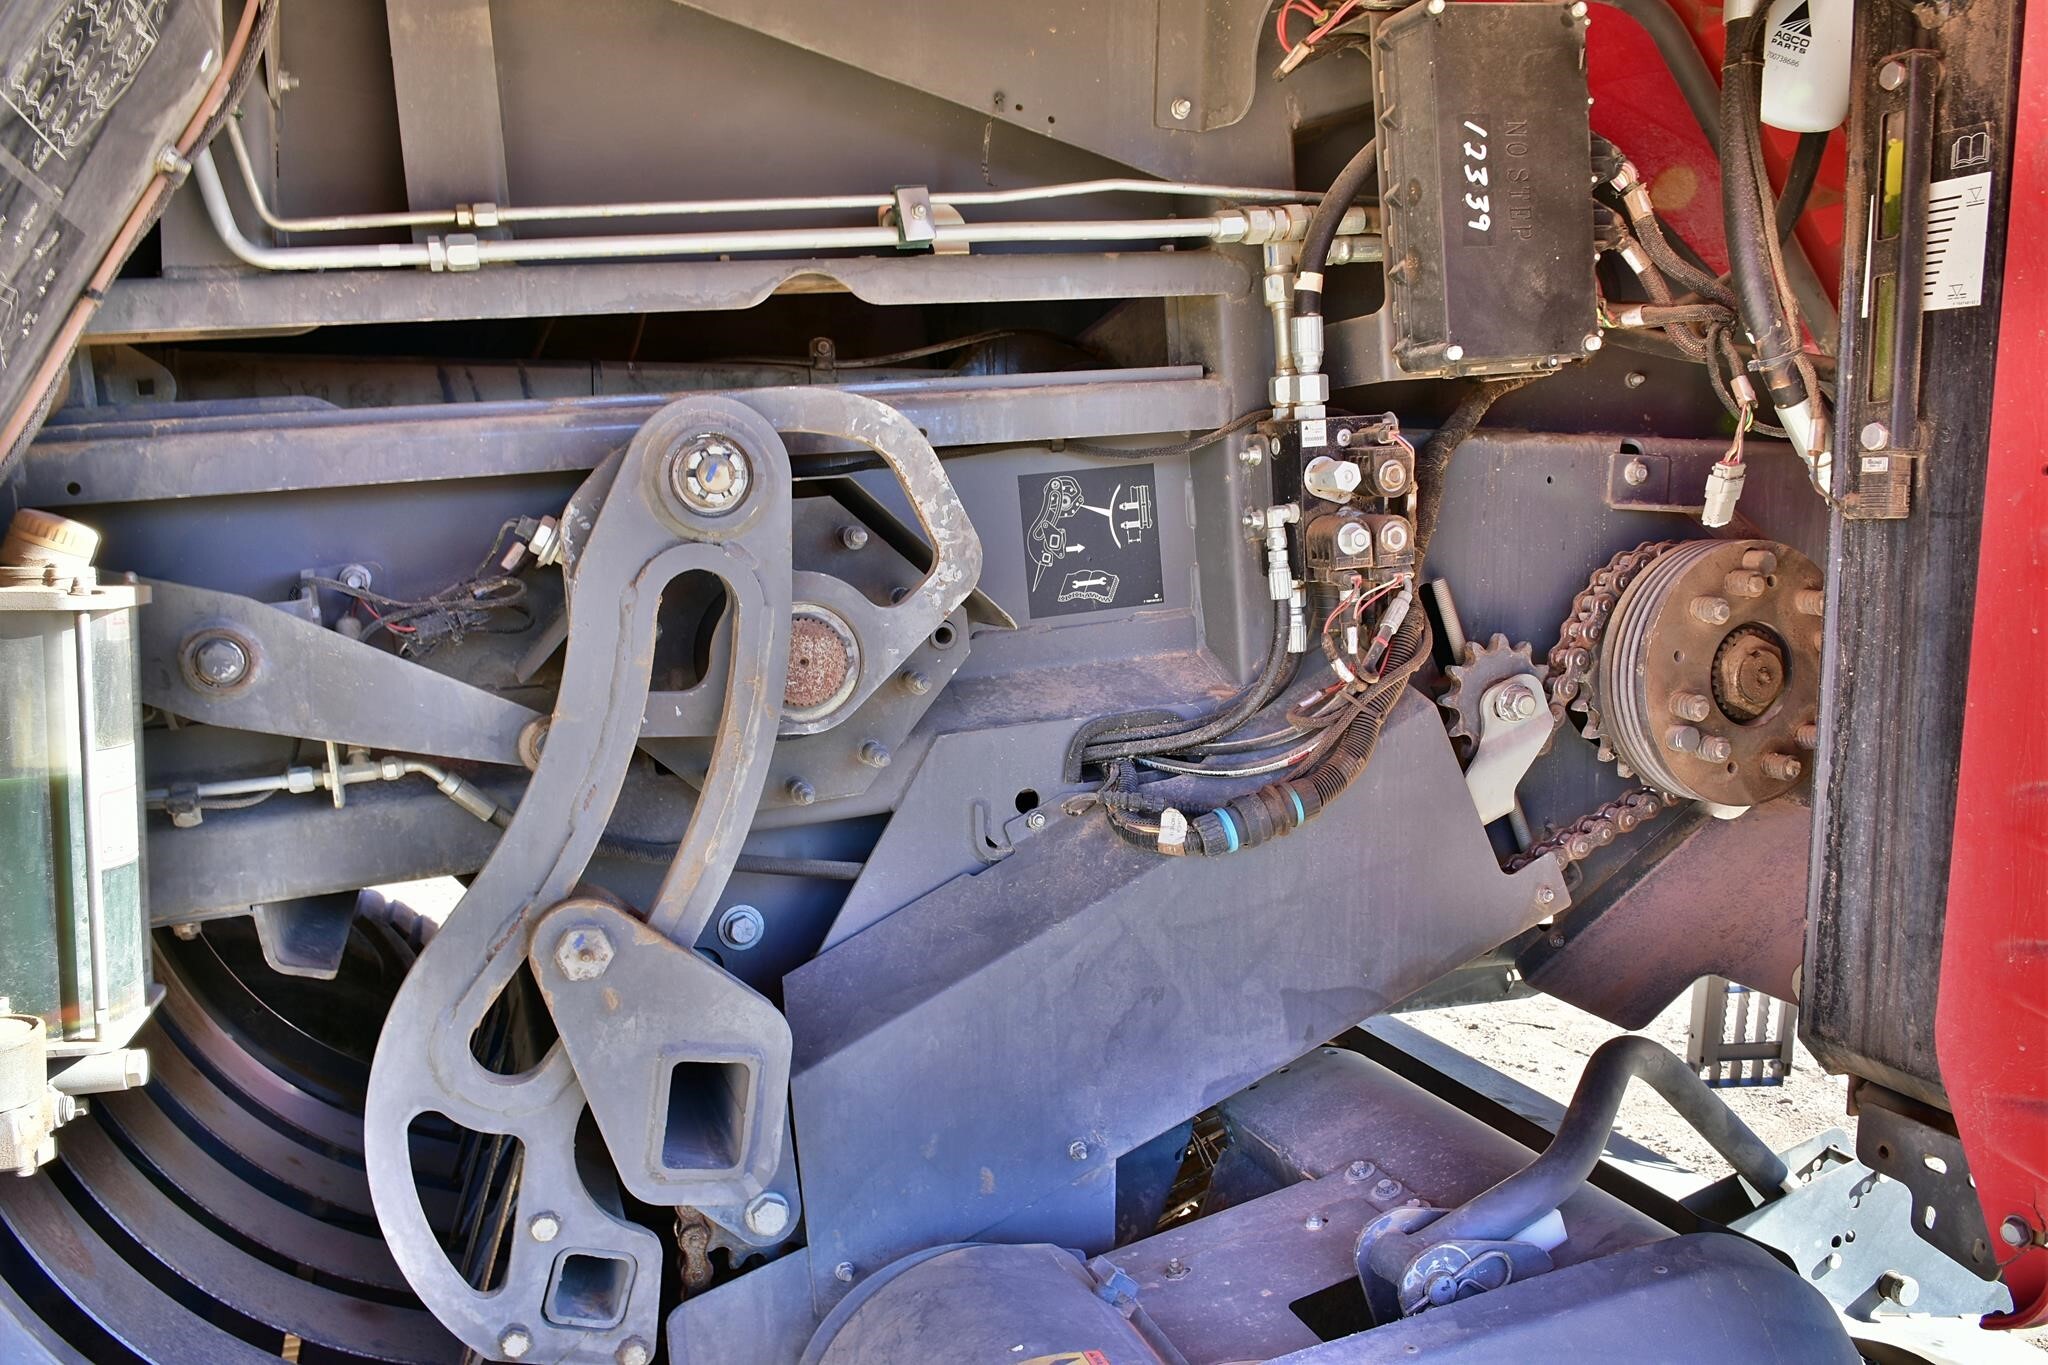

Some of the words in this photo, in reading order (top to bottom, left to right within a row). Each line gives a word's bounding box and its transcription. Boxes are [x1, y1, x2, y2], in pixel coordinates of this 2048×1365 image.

[1771, 38, 1807, 54] PARTS
[1774, 30, 1810, 48] AGCO
[1504, 119, 1528, 158] NO
[1463, 120, 1492, 232] 12339
[1506, 168, 1534, 241] STEP
